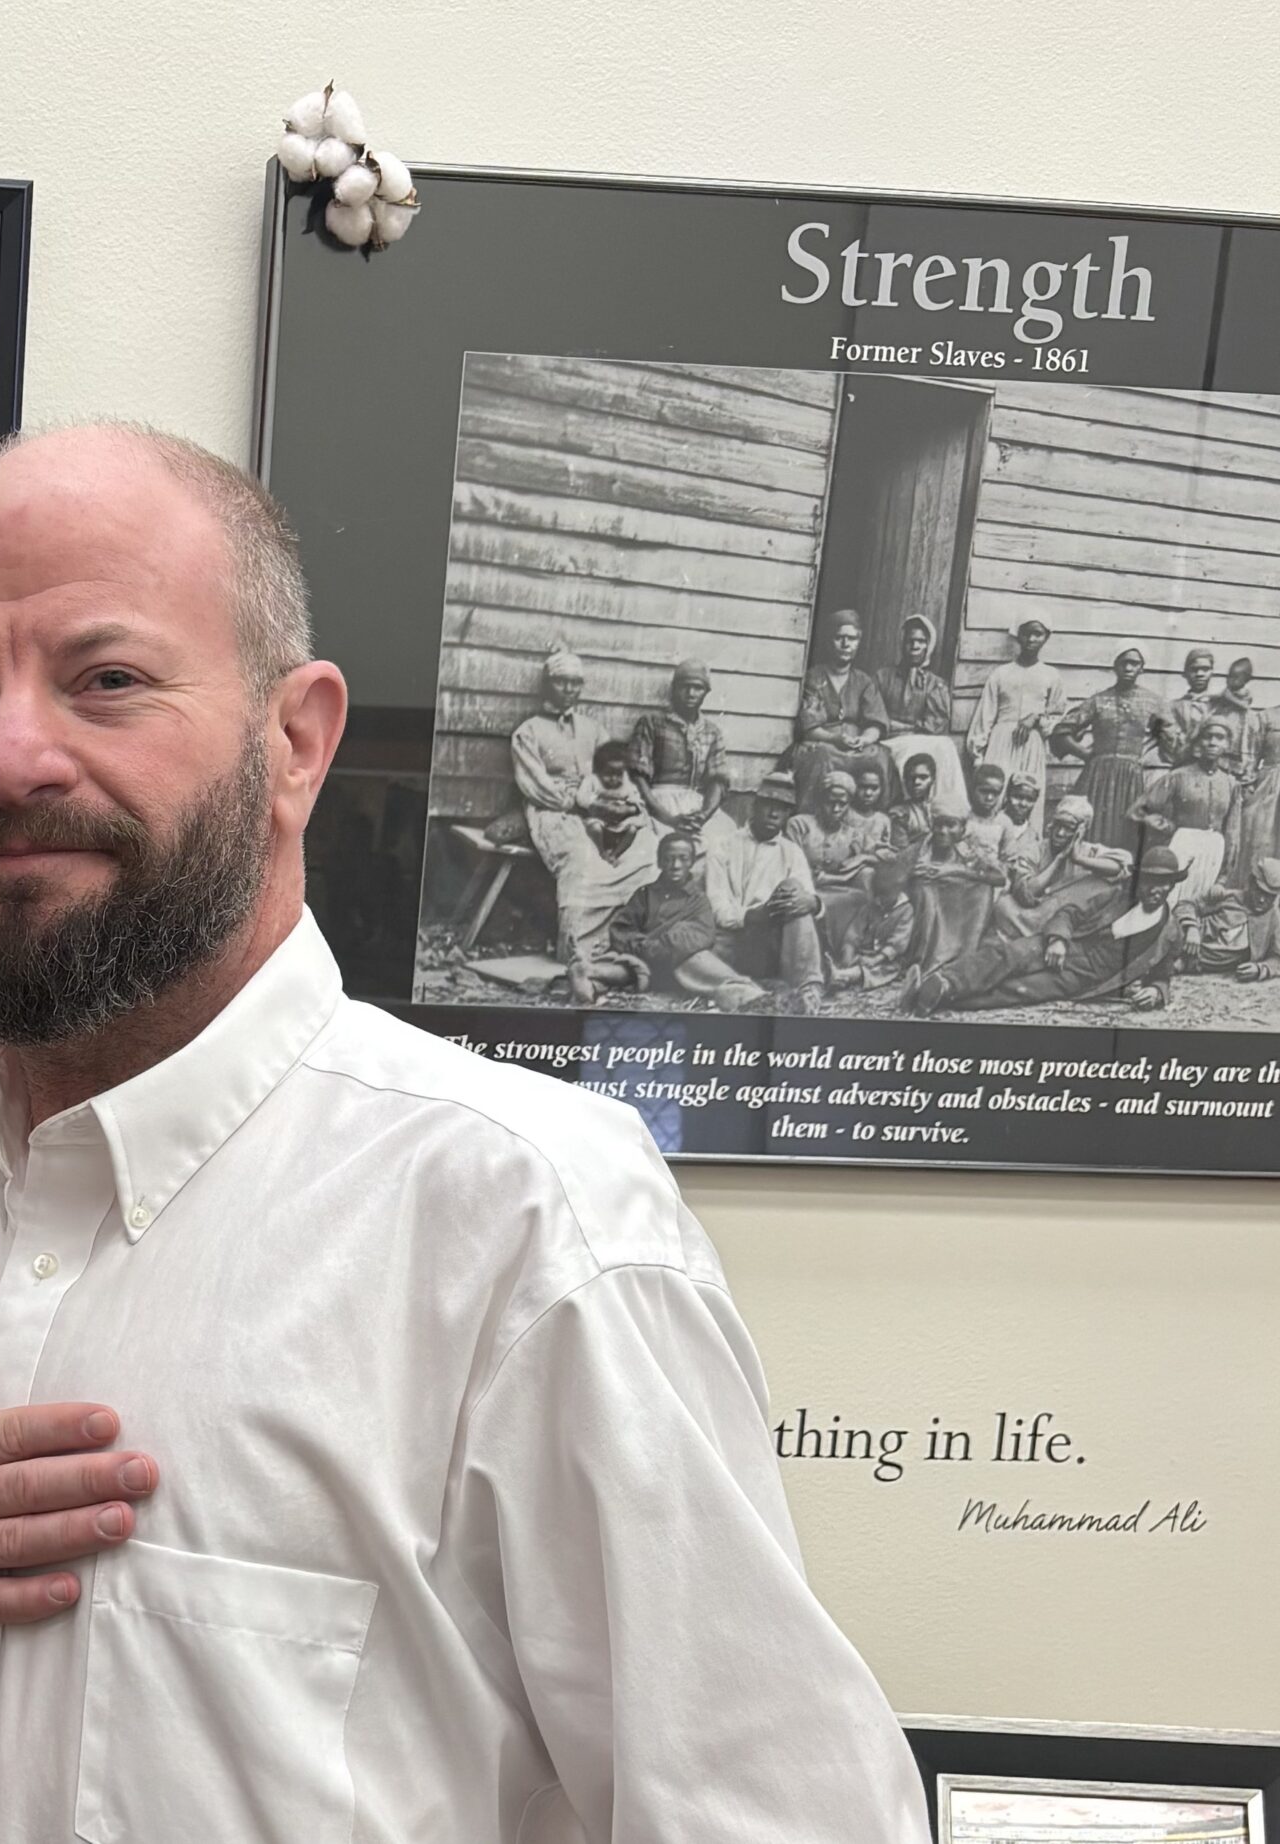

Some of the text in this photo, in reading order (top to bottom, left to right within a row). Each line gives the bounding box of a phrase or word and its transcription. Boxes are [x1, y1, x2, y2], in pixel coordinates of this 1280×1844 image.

[781, 222, 1156, 344] Strength
[830, 337, 922, 364] Former
[929, 341, 1005, 368] Slaves
[1031, 347, 1090, 373] 1861
[493, 1043, 600, 1067] strongest
[606, 1041, 685, 1069] people
[692, 1043, 716, 1066] in
[723, 1043, 761, 1067] the
[767, 1046, 835, 1069] world
[838, 1050, 905, 1072] aren't
[911, 1049, 974, 1074] those
[979, 1057, 1034, 1077] most
[1037, 1057, 1153, 1084] protected;
[1158, 1058, 1208, 1088] they
[1212, 1066, 1252, 1083] are
[633, 1077, 730, 1107] struggle
[735, 1081, 822, 1109] against
[827, 1082, 932, 1114] adversity
[937, 1086, 984, 1110] and
[987, 1087, 1092, 1113] obstacles
[1114, 1092, 1161, 1115] and
[1164, 1098, 1274, 1118] surmount
[771, 1114, 829, 1138] them
[851, 1121, 875, 1141] to
[881, 1121, 970, 1144] survive.
[923, 1417, 973, 1462] in
[991, 1412, 1086, 1464] life.
[957, 1497, 1207, 1534] Muhammad Ali
